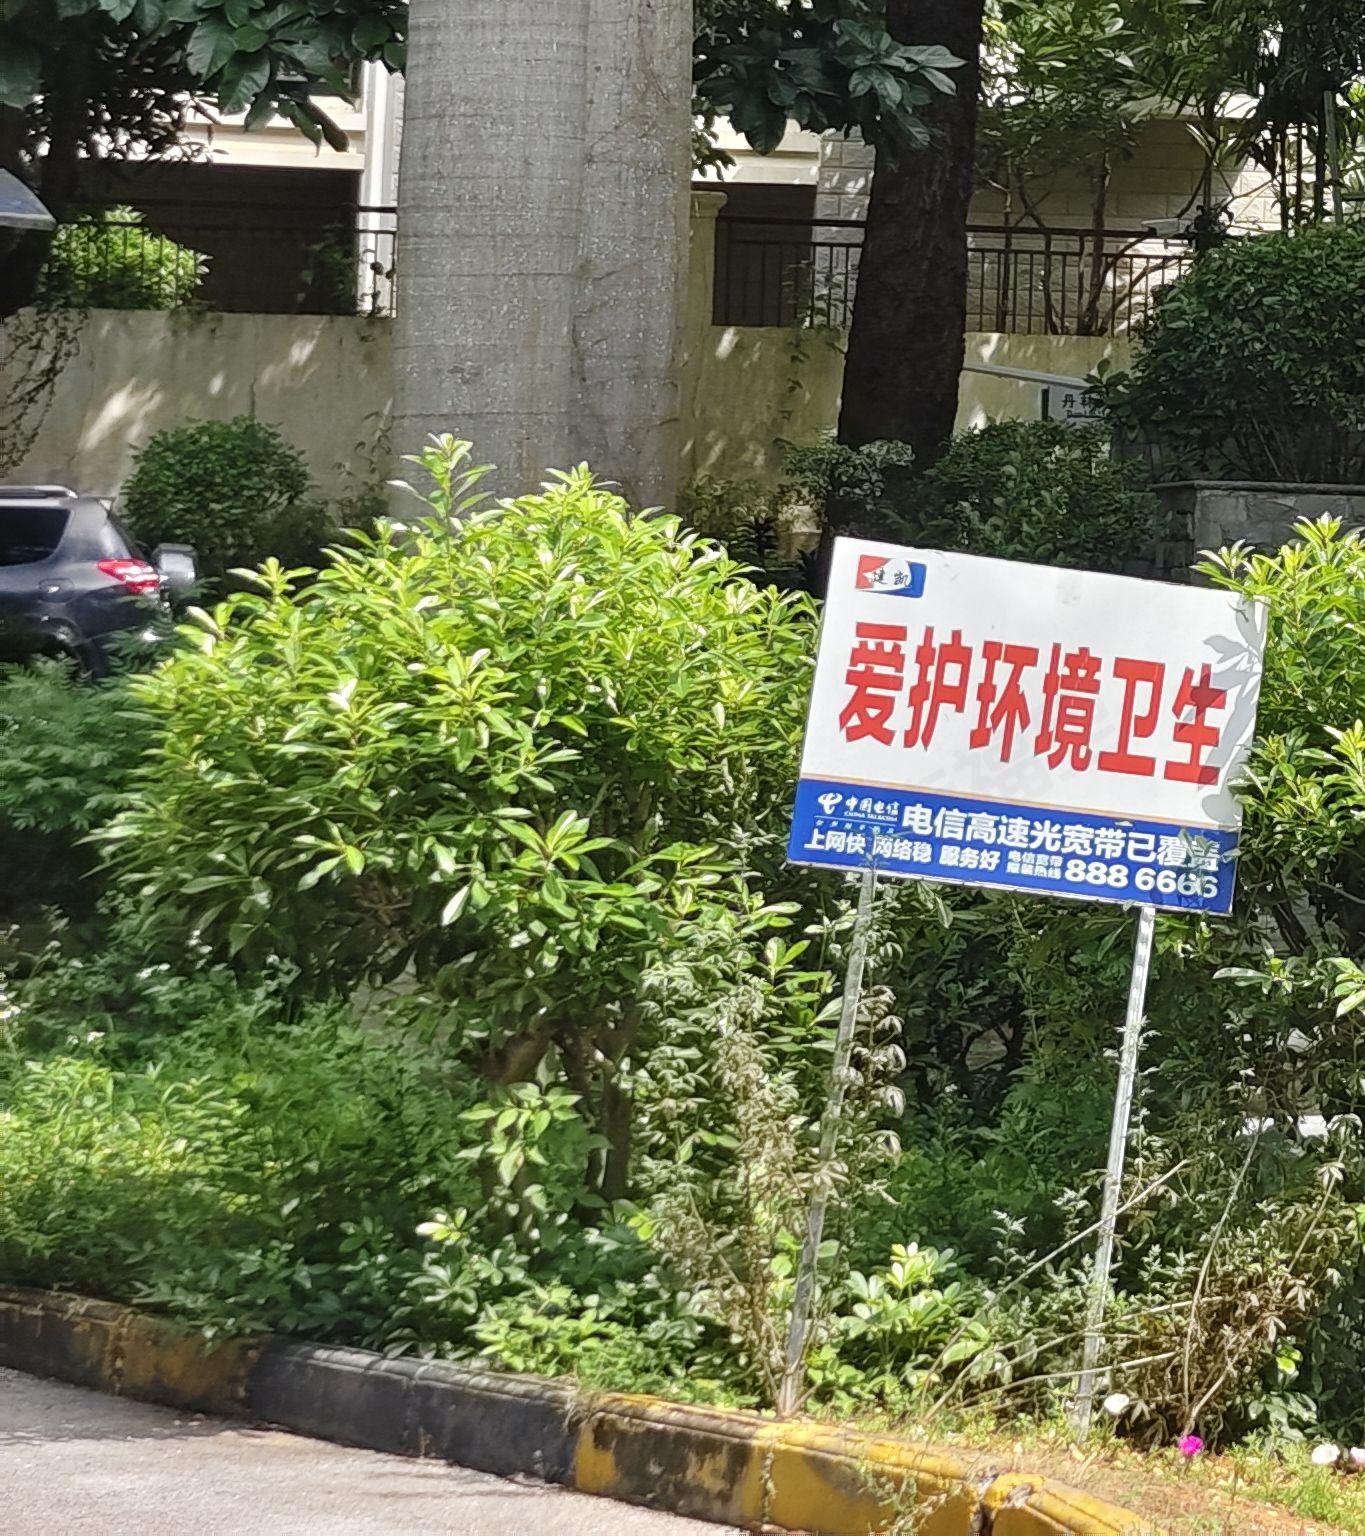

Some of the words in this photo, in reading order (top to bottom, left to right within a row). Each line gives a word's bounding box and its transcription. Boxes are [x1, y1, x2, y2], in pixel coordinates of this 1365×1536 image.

[839, 621, 1228, 787] 爱护环境卫生
[845, 796, 900, 817] 中国电信
[804, 828, 867, 855] 上网快
[872, 834, 933, 863] 网络稳
[939, 845, 1001, 872] 服务好
[902, 804, 1221, 872] 电信高速光宽带已覆盖
[1064, 859, 1129, 889] 888
[1135, 867, 1219, 899] 6666
